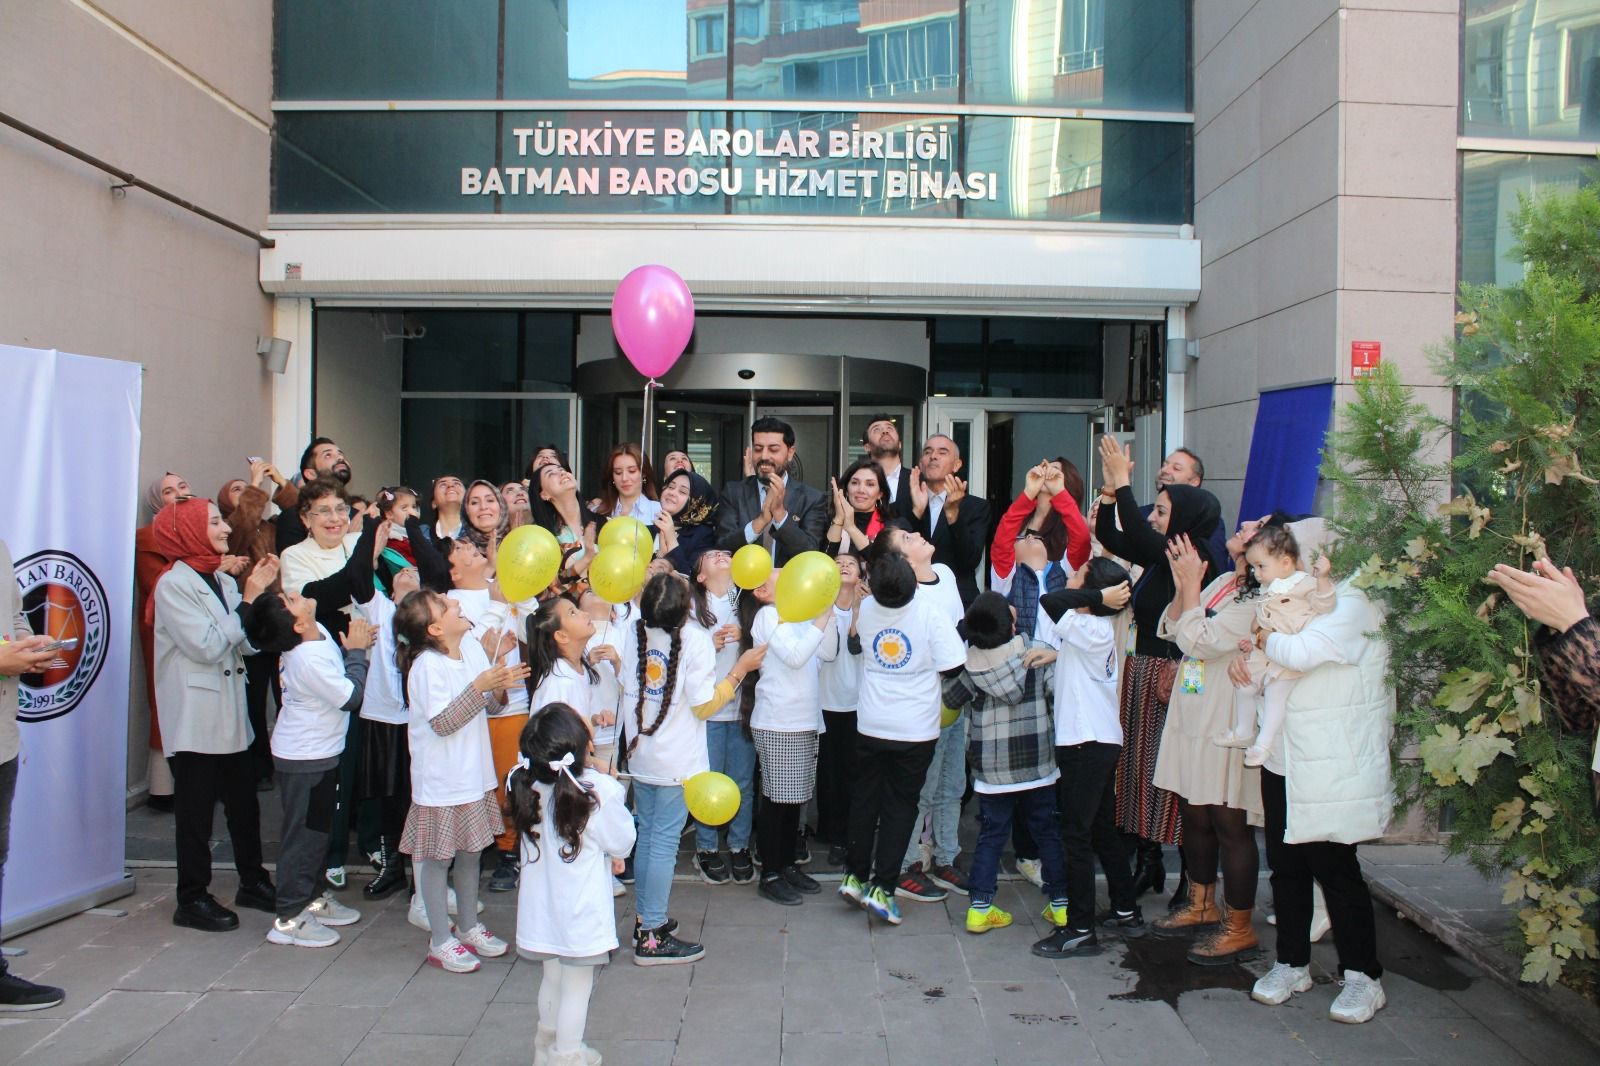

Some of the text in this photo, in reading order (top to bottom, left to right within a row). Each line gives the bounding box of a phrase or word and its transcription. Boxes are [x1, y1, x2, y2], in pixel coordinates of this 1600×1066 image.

[513, 121, 948, 160] TÜRKİYE BAROLAR BİRLİĞİ
[461, 161, 998, 201] BATMAN BAROSU HİZMET BİNASI
[1363, 352, 1370, 365] 1
[54, 564, 100, 624] BAROSU
[32, 694, 55, 709] 1991
